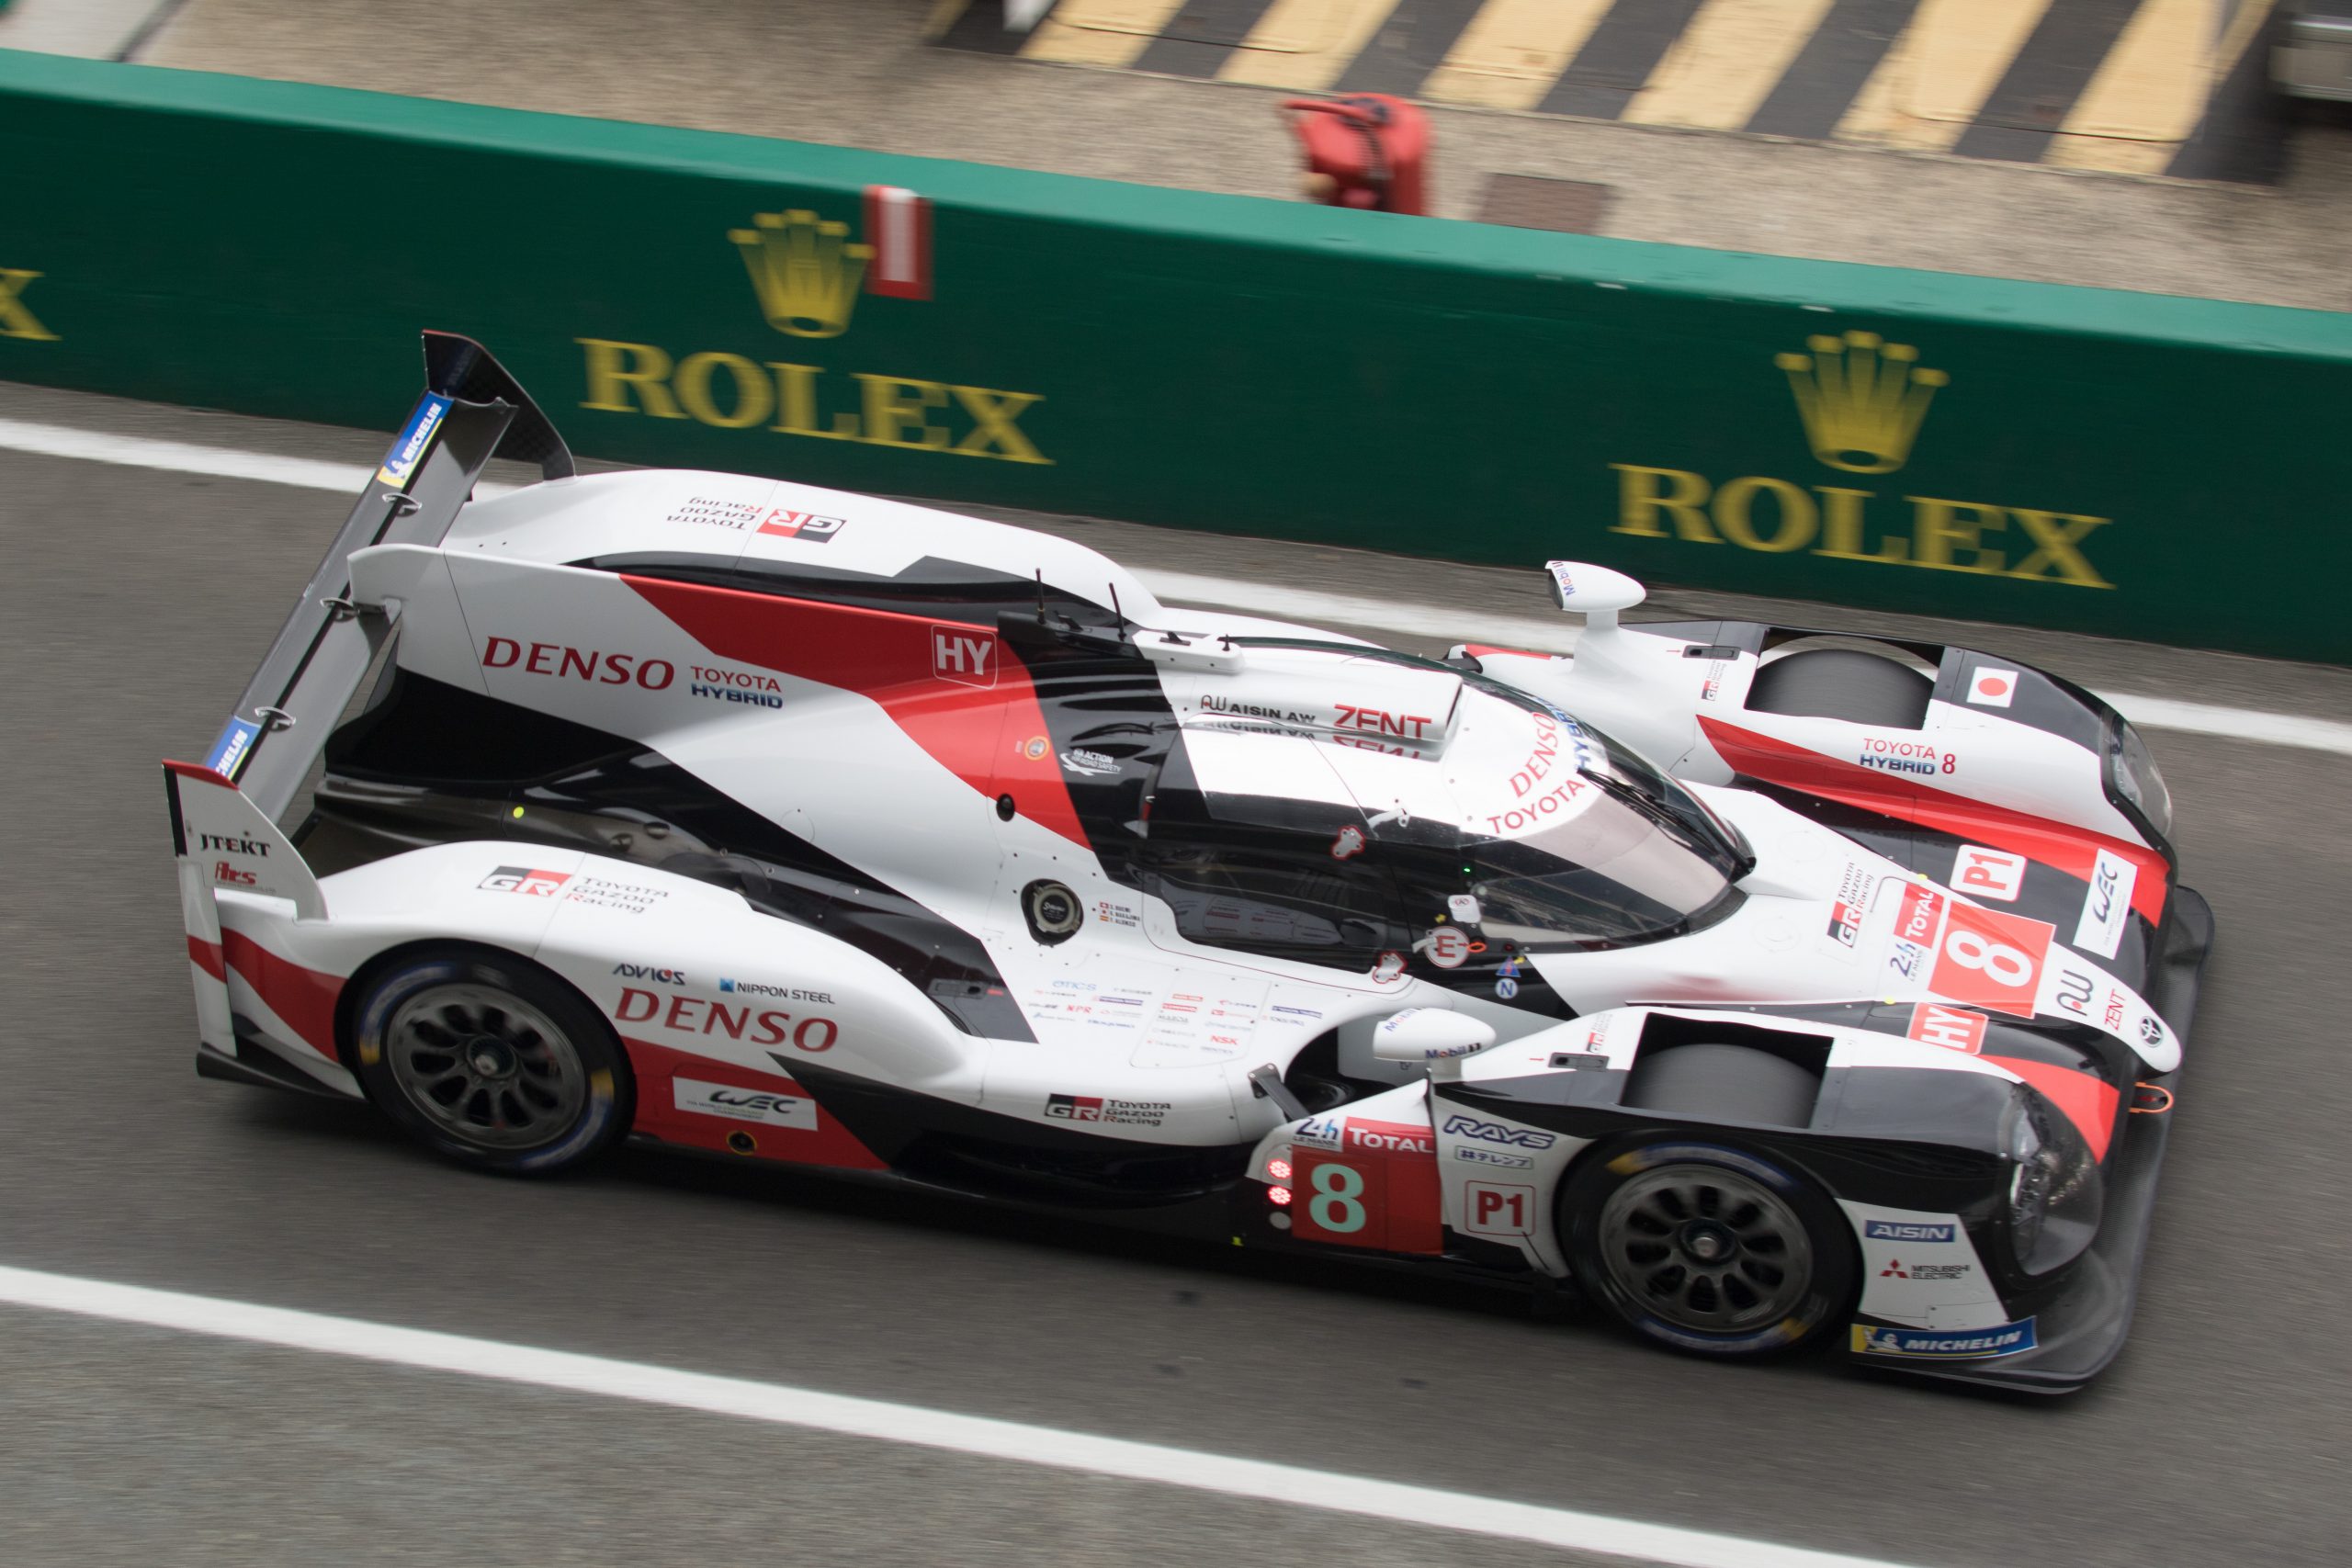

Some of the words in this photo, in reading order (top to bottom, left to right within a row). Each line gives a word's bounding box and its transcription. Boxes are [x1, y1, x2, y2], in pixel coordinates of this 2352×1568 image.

[574, 338, 1056, 465] ROLEX
[401, 402, 442, 461] MICHELIN
[680, 507, 756, 521] GAZOO
[689, 497, 763, 513] Racing
[666, 515, 746, 530] TOYOTA
[764, 509, 845, 536] GR
[1608, 463, 2117, 590] ROLEX
[482, 637, 674, 690] DENSO
[935, 634, 992, 676] HY
[690, 665, 781, 693] TOYOTA
[691, 682, 783, 709] HYBRID
[1229, 704, 1281, 718] AISIN
[1286, 712, 1316, 723] AW
[1333, 704, 1431, 739] ZENT
[215, 728, 248, 777] CHELIN
[1084, 750, 1114, 764] ACTION
[1509, 711, 1558, 798] DENSO
[1863, 738, 1936, 760] TOYOTA
[1860, 754, 1936, 775] HYBRID
[1941, 753, 1956, 774] 8
[1487, 779, 1586, 834] TOYOTA
[200, 834, 270, 858] JTEKT
[1838, 862, 1855, 898] TOYOTA
[1962, 852, 2014, 891] P1
[479, 873, 562, 897] GR
[573, 885, 654, 904] GAZOO
[583, 876, 669, 897] TOYOTA
[1848, 869, 1863, 905] GAZOO
[1856, 874, 1874, 908] Racing
[2093, 862, 2118, 923] WEC
[565, 893, 645, 914] Racing
[1905, 892, 1934, 937] TOTAL
[1838, 907, 1862, 948] GR
[1437, 935, 1456, 958] E
[1946, 931, 2033, 988] 8
[737, 982, 787, 998] NIPPON
[792, 989, 836, 1005] STEEL
[1500, 982, 1513, 996] N
[614, 987, 838, 1053] DENSO
[2105, 987, 2126, 1030] ZENT
[1920, 1006, 1974, 1050] HY
[1426, 1045, 1467, 1058] Mobil
[709, 1090, 797, 1114] WEC
[1046, 1102, 1101, 1122] GR
[1105, 1108, 1164, 1118] GAZOO
[1108, 1100, 1171, 1110] TOYOTA
[1103, 1115, 1162, 1127] Racing
[1295, 1117, 1339, 1140] 24h
[1442, 1114, 1556, 1150] RAYS
[1347, 1126, 1434, 1154] TOTAL
[1308, 1163, 1366, 1233] 8
[1476, 1190, 1524, 1227] P1
[1872, 1224, 1951, 1240] AISIN
[1911, 1264, 1970, 1273] MITSUBISHI
[1911, 1271, 1963, 1280] ELECTRIC
[1905, 1331, 2022, 1351] MICHELIN
